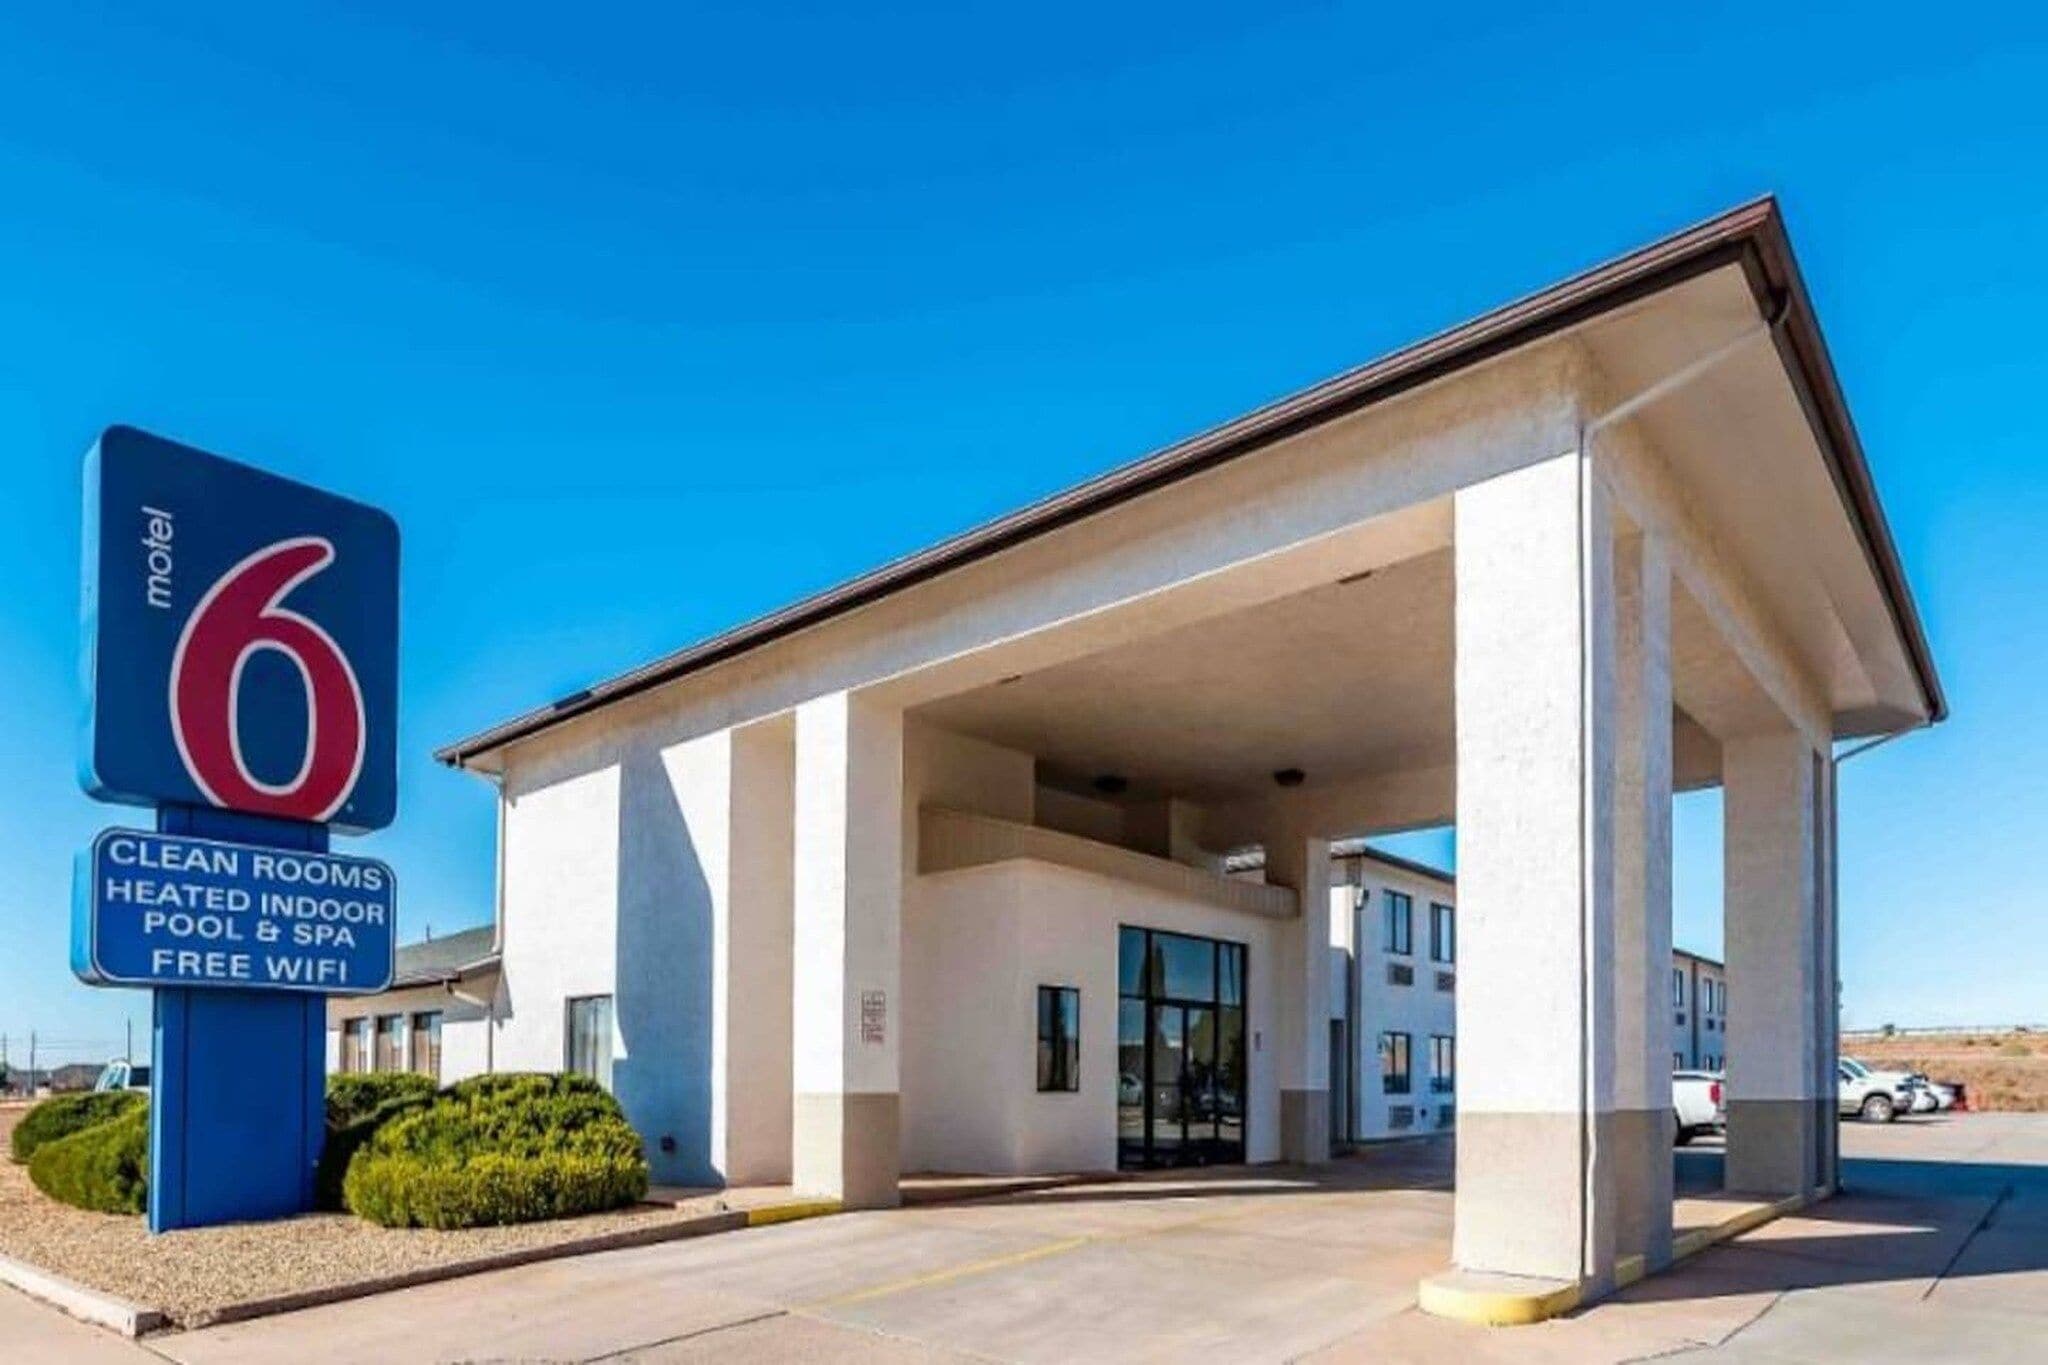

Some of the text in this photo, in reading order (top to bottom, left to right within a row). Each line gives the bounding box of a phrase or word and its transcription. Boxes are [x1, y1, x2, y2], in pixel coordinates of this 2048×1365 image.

[140, 505, 172, 609] motel
[170, 537, 366, 820] 6
[109, 839, 382, 891] CLEAN ROOMS
[106, 879, 385, 925] HEATED INDOOR
[144, 911, 355, 948] POOL & SPA
[152, 950, 347, 983] FREE WIFI
